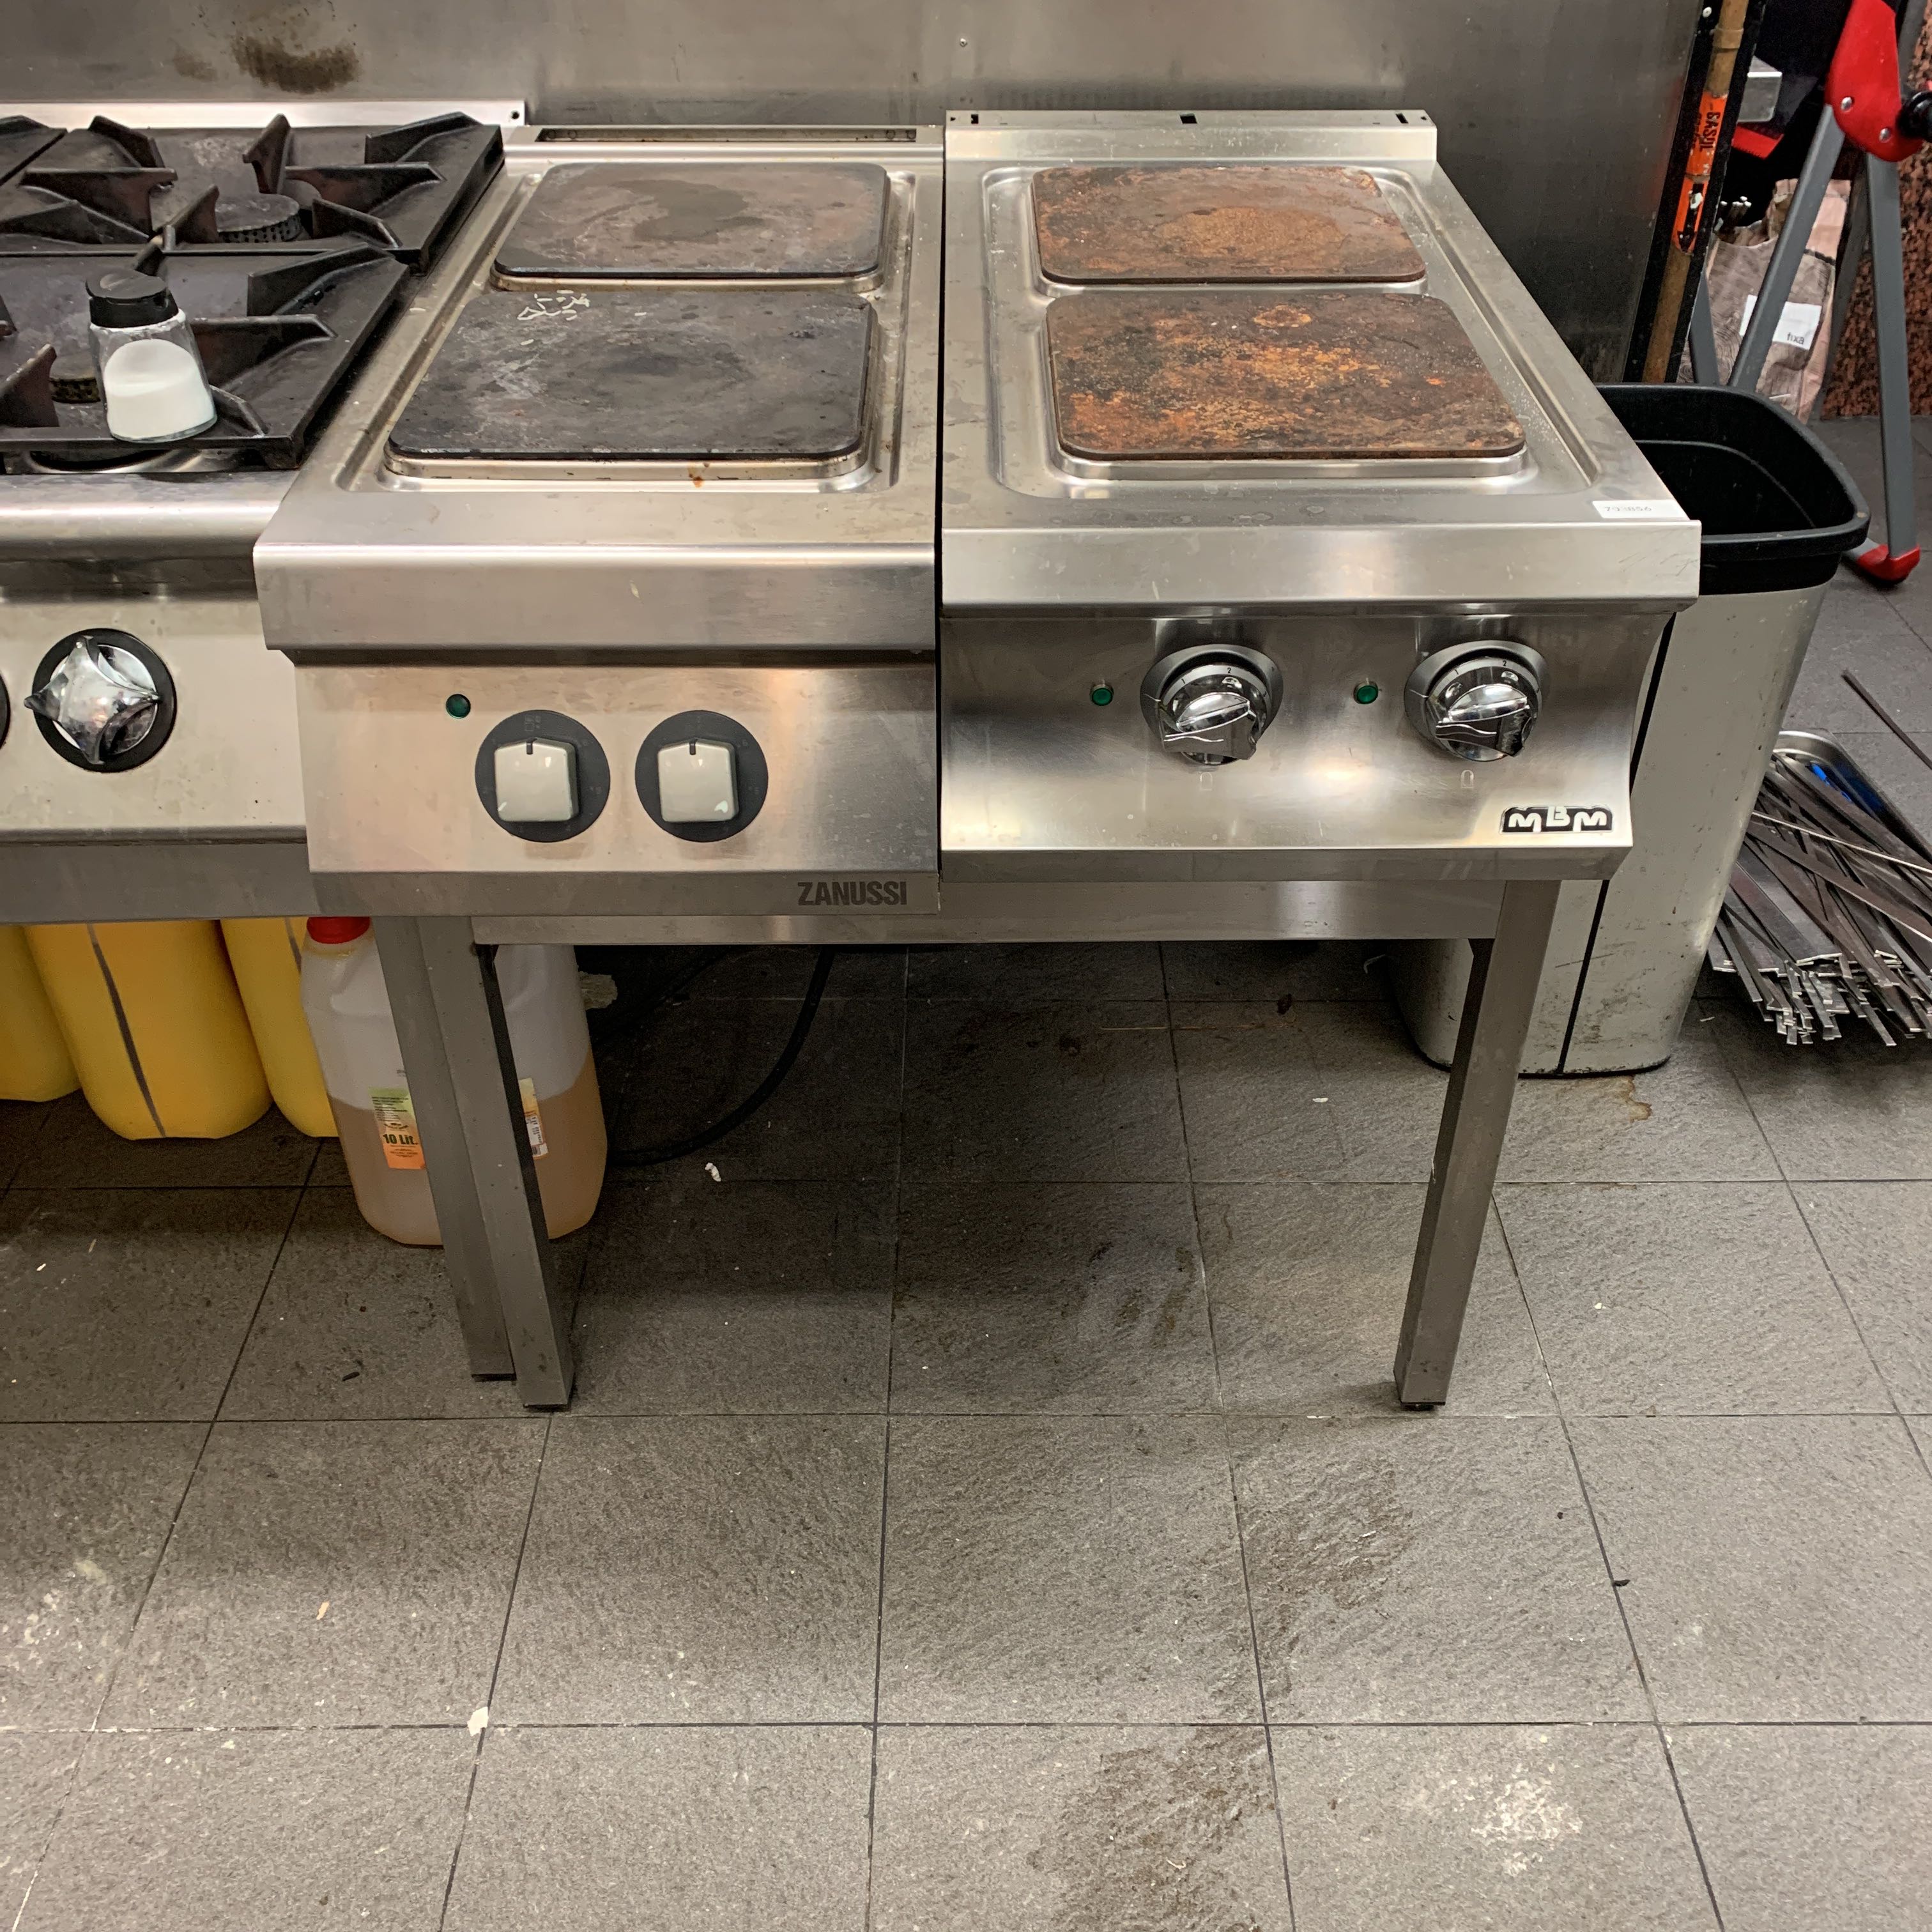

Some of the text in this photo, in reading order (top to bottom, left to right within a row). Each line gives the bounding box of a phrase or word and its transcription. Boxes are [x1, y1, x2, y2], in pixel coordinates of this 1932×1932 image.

[1786, 332, 1805, 345] fixa
[1507, 806, 1608, 832] MBM
[797, 880, 907, 906] ZANUSSI
[382, 1133, 418, 1145] 10 Lit.
